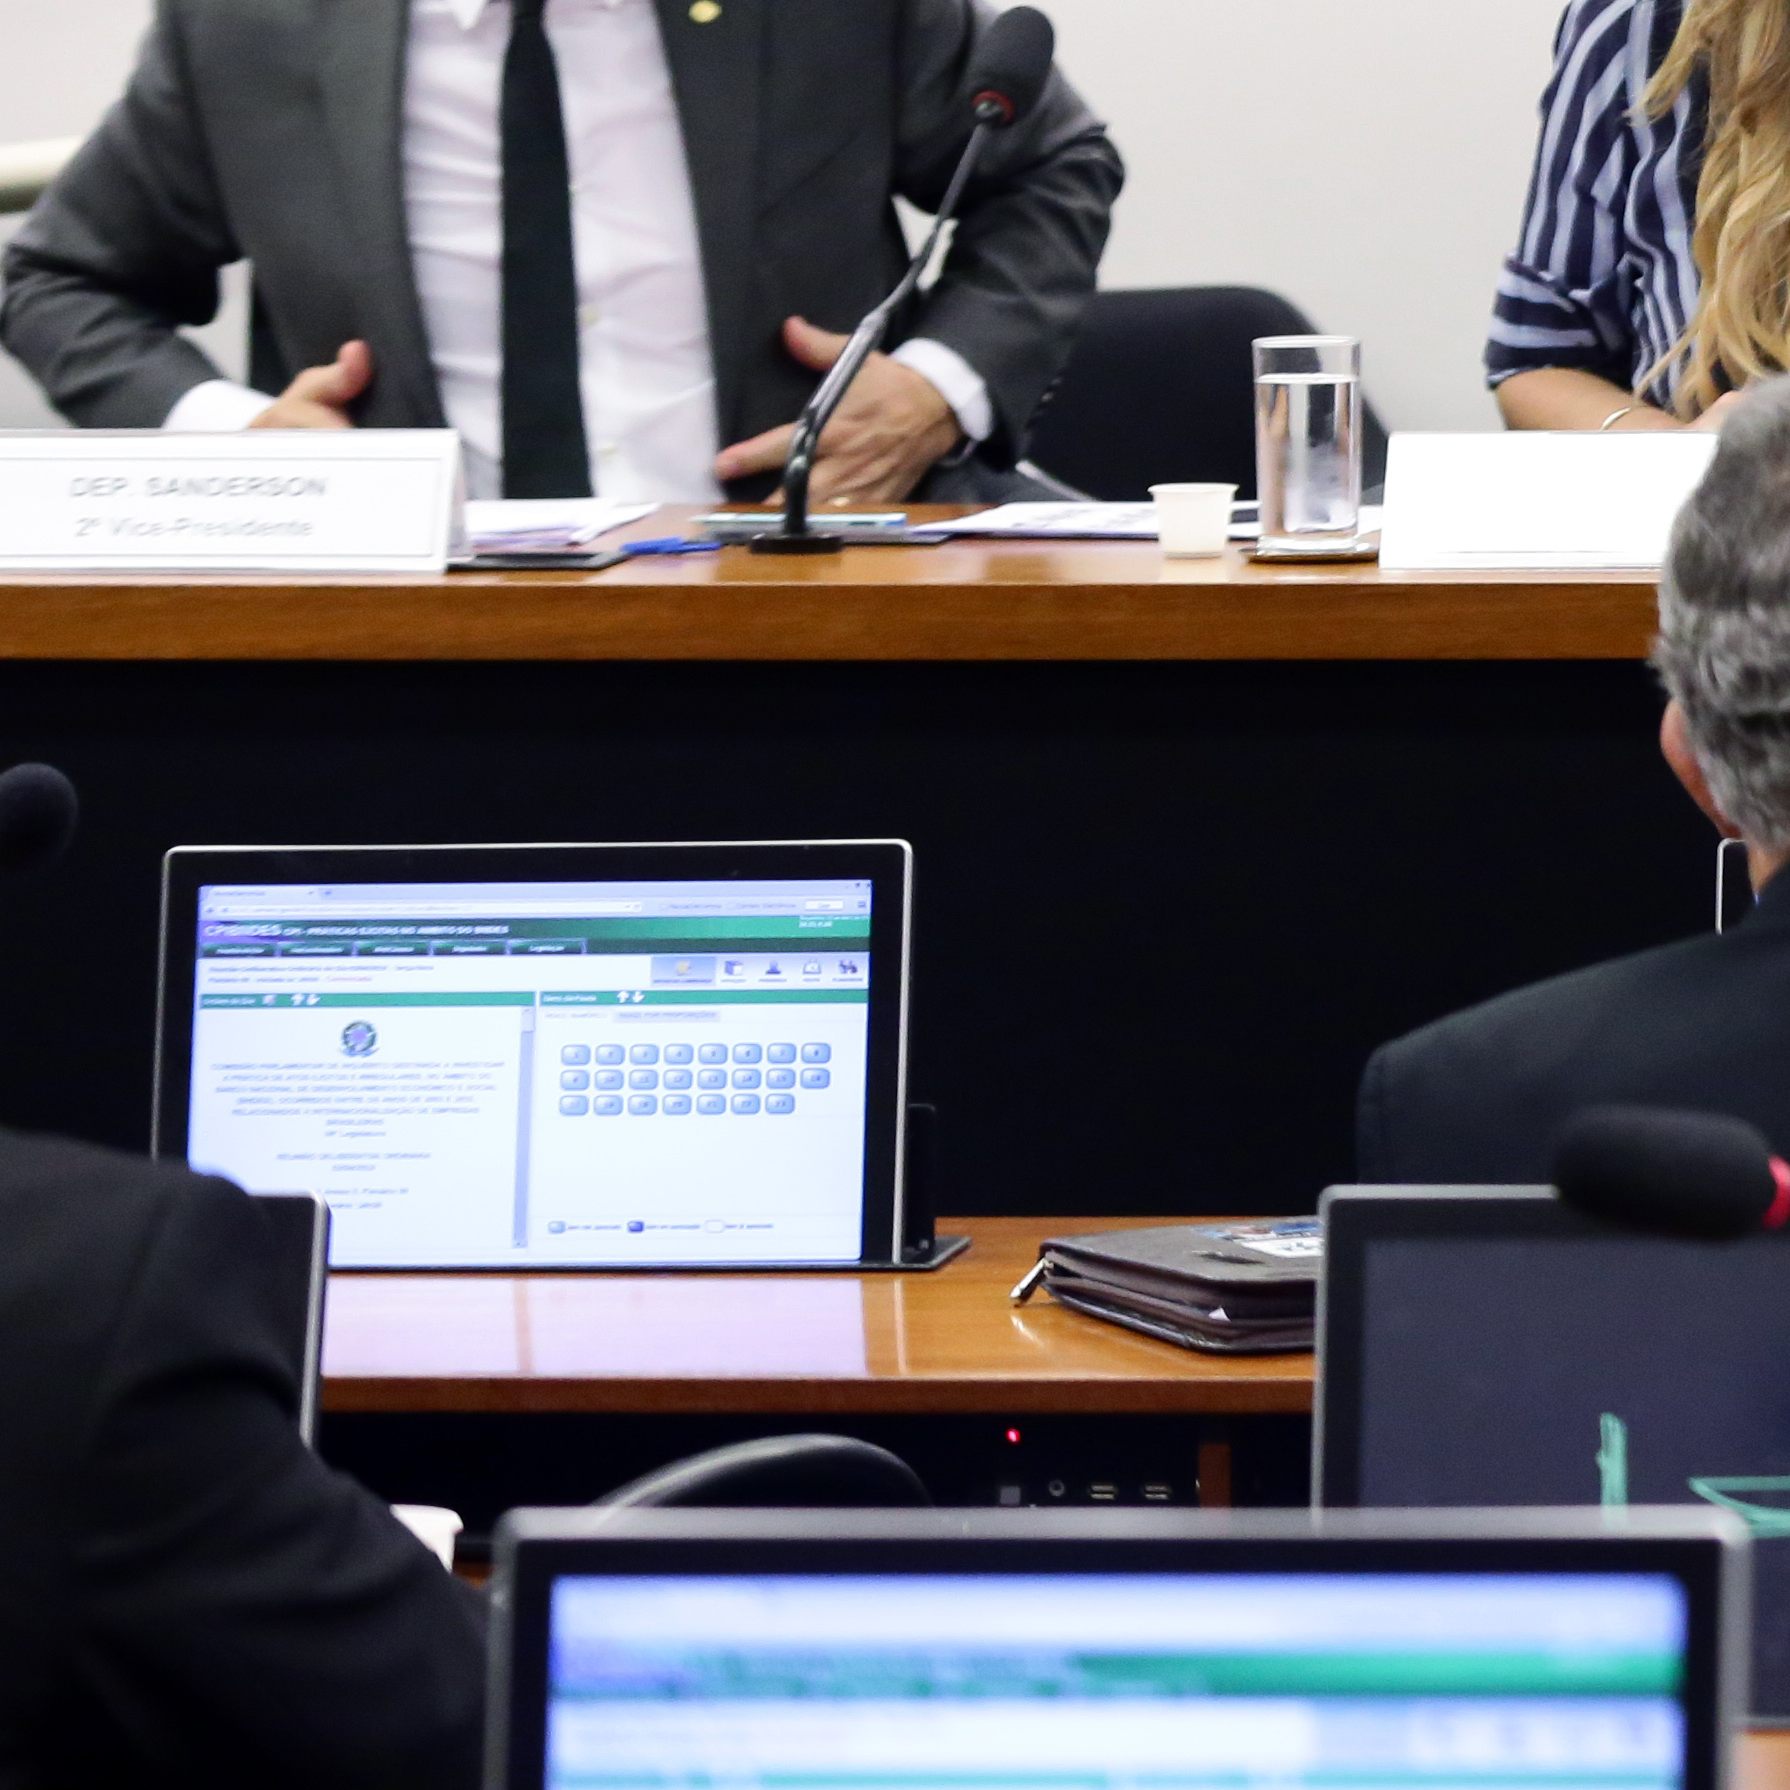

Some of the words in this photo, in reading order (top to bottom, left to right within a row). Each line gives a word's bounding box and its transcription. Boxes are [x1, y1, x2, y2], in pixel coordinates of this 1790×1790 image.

[70, 475, 136, 498] DEP.
[147, 475, 327, 498] SANDERSON
[109, 516, 313, 538] Vice-Presidente
